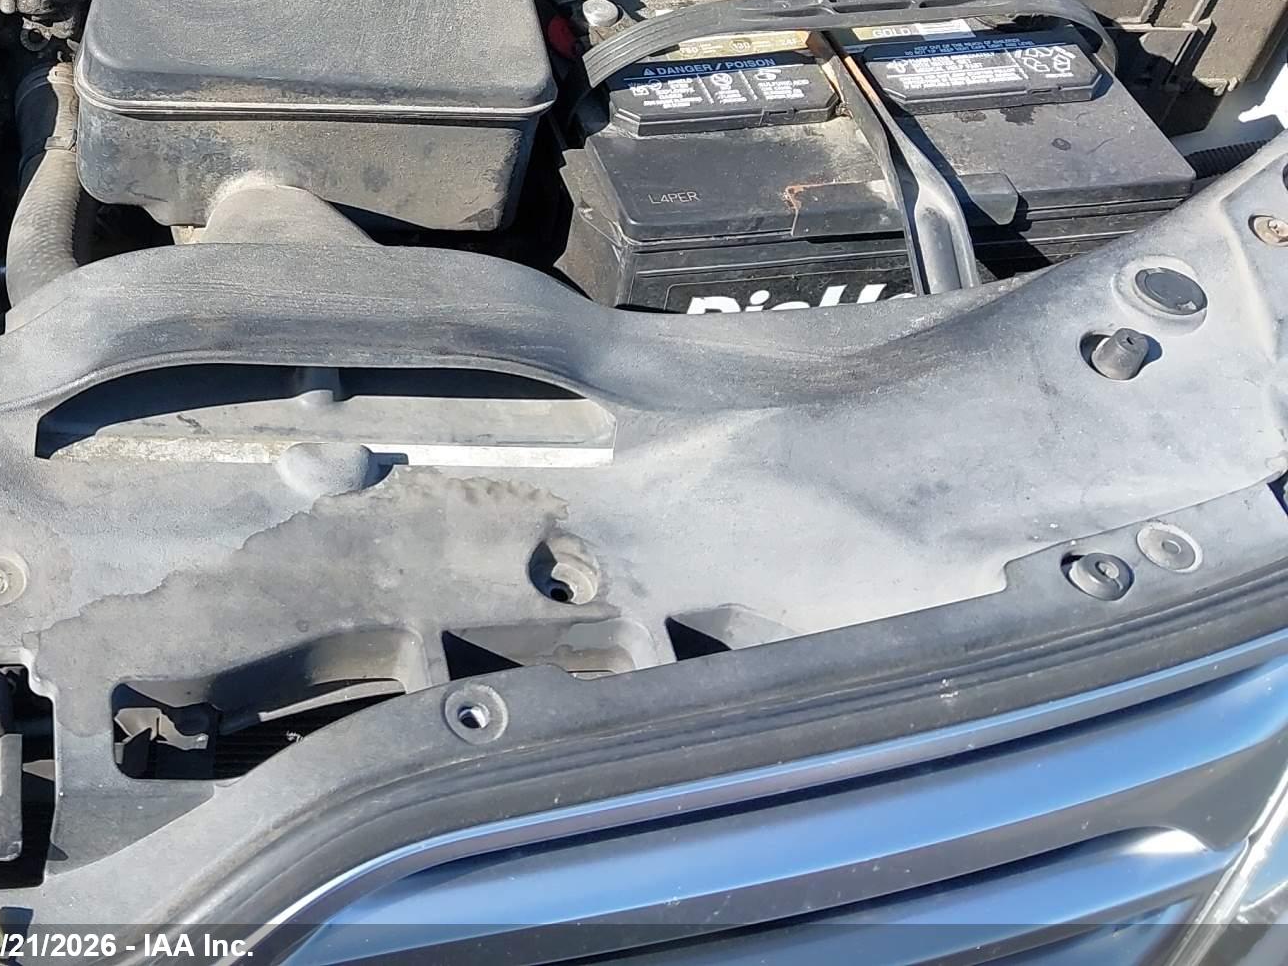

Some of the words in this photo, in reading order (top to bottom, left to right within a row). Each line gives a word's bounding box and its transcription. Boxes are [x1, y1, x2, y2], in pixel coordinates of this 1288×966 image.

[872, 27, 911, 37] GOLD
[656, 63, 712, 75] DANGER
[725, 58, 776, 70] POISON
[648, 190, 700, 205] L4PER
